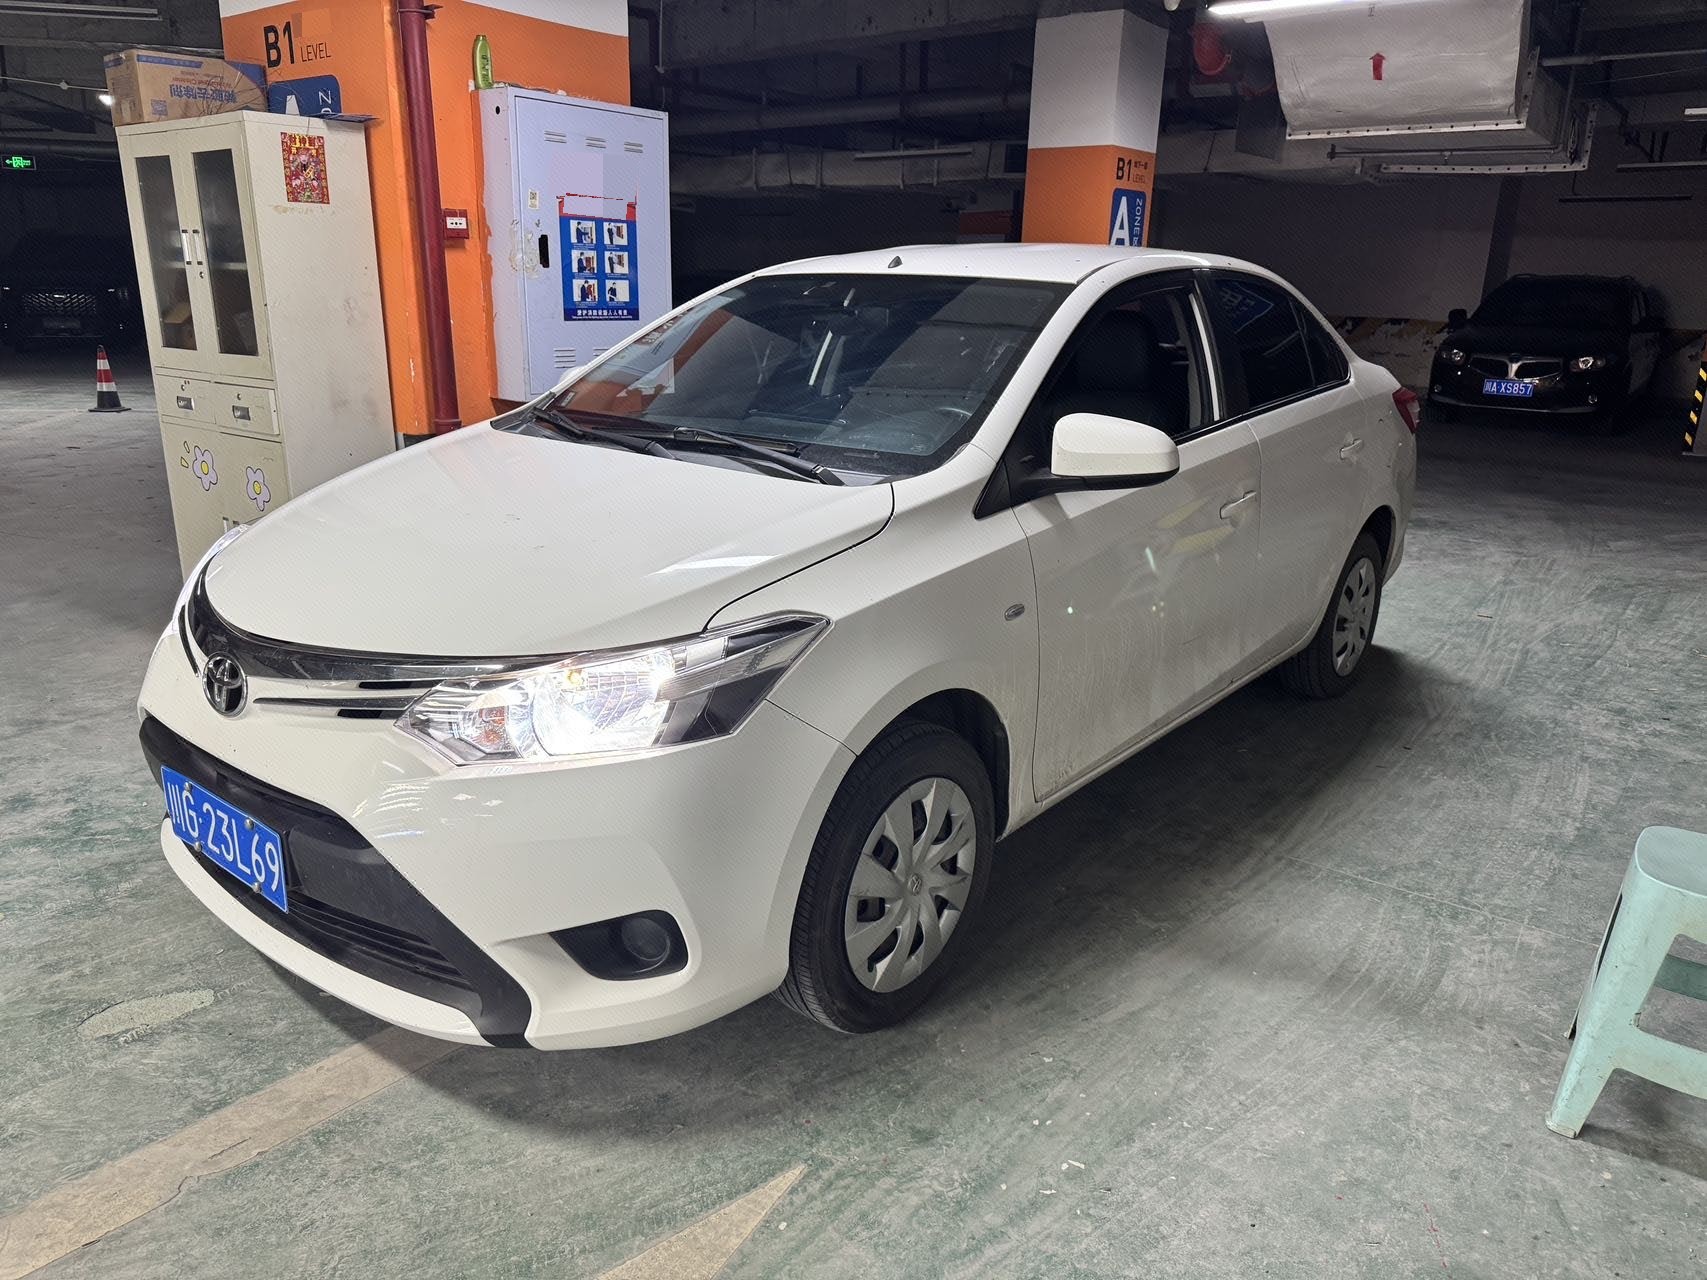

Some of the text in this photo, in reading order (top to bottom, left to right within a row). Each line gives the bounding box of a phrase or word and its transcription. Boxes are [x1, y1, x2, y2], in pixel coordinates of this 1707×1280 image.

[264, 21, 332, 68] B1 LEVEL
[1116, 157, 1132, 182] B1
[1109, 196, 1130, 247] A
[1133, 198, 1143, 236] ZONE
